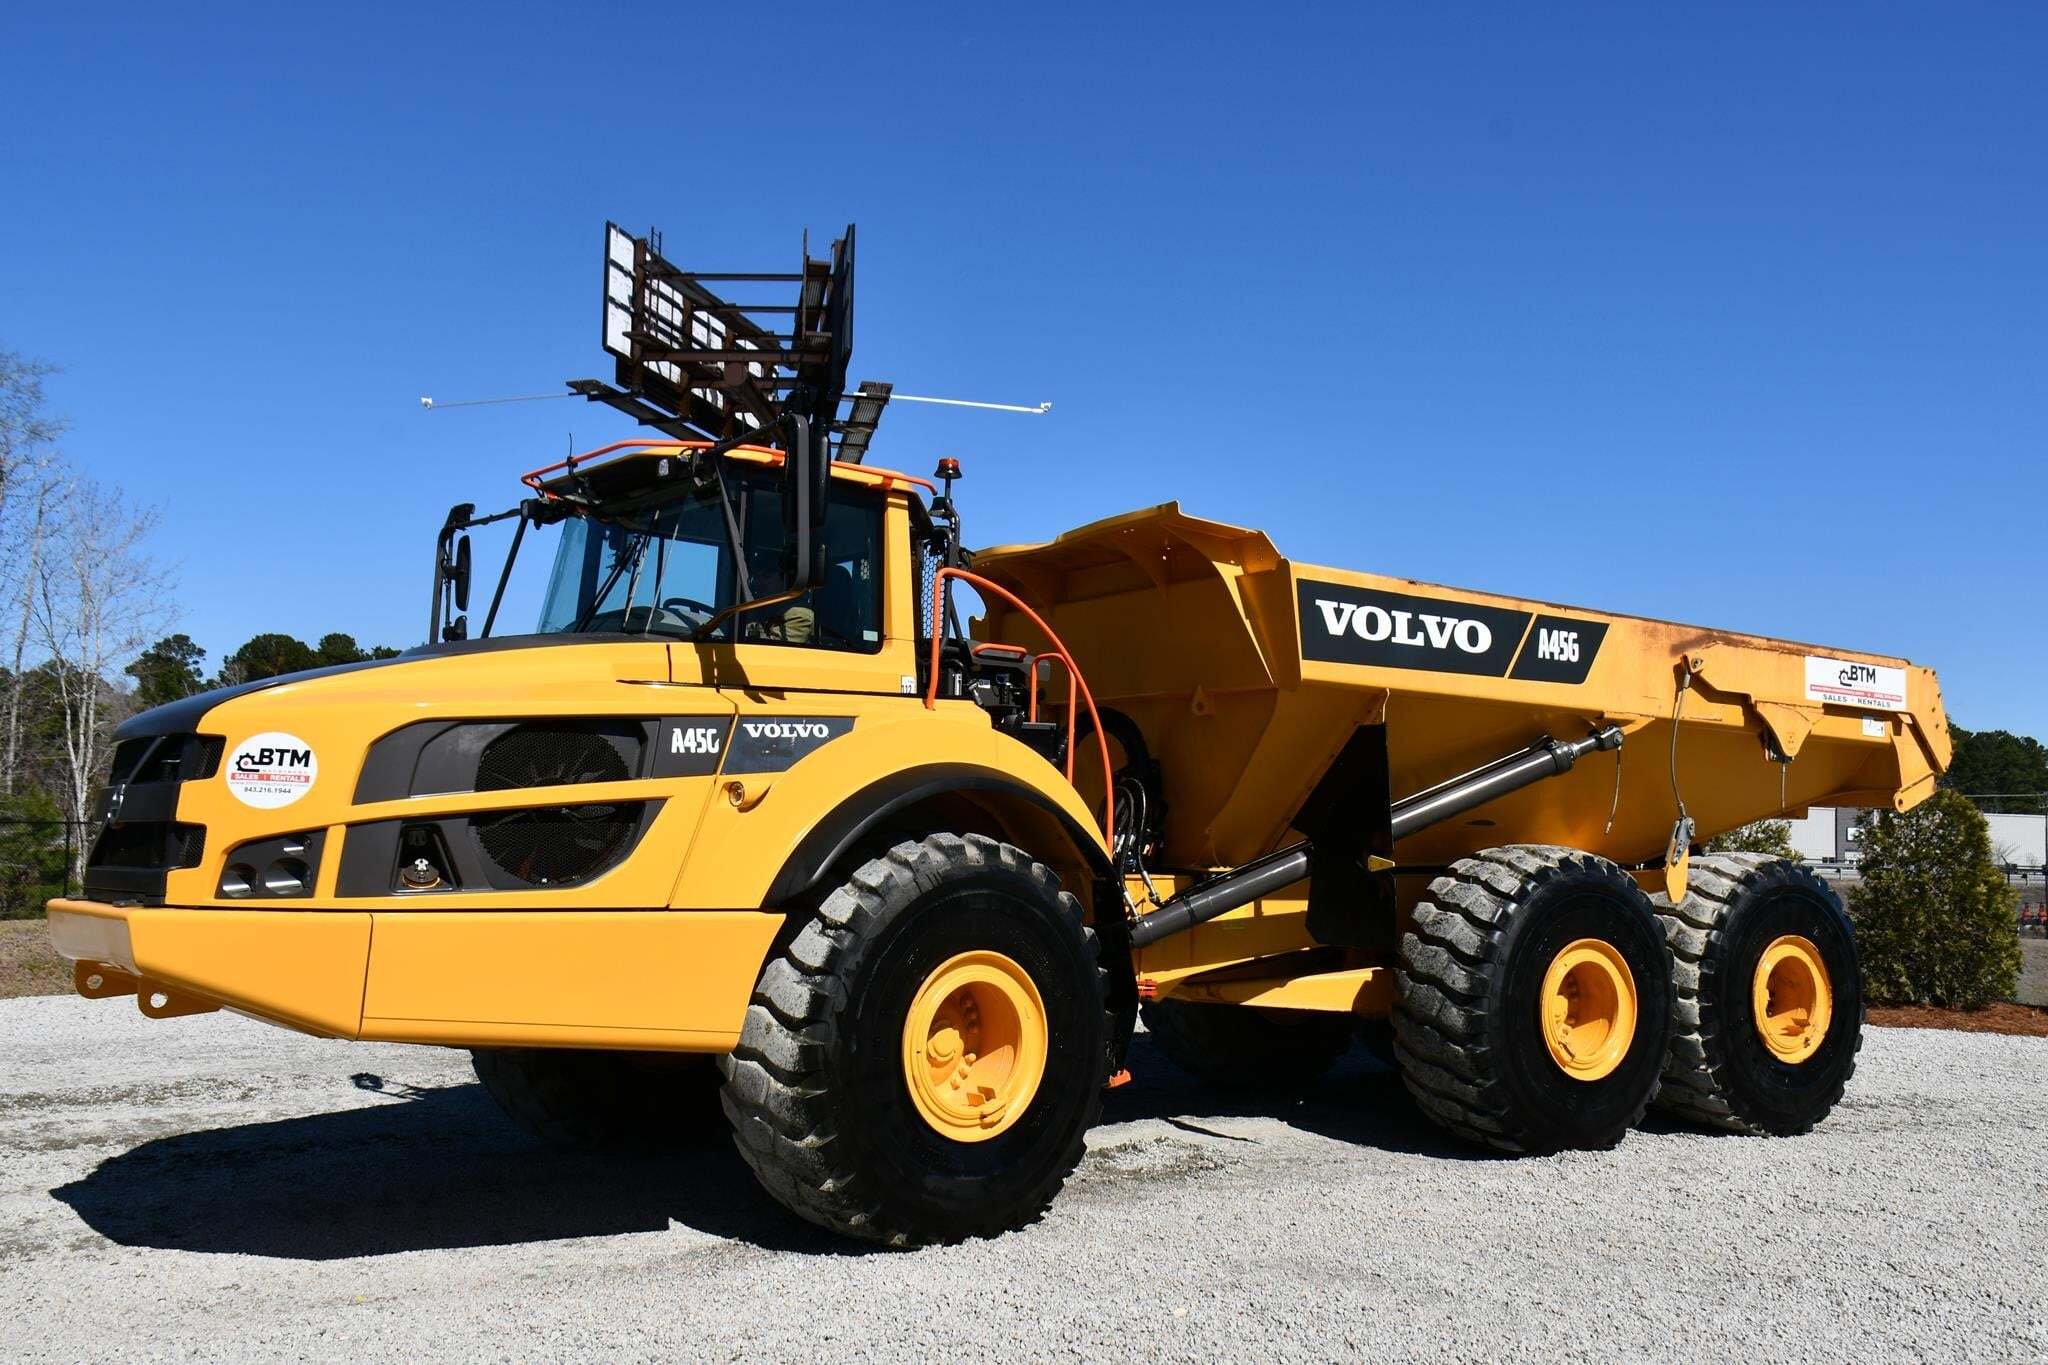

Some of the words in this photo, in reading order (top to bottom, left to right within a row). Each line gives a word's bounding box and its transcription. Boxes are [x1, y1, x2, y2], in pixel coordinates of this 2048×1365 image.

[1315, 599, 1492, 654] VOLVO
[1538, 628, 1580, 662] A45G
[1850, 665, 1876, 683] BTM
[1823, 694, 1848, 703] SALES
[1857, 698, 1891, 708] RENTALS
[742, 723, 830, 738] VOLVO
[258, 748, 311, 767] BTM
